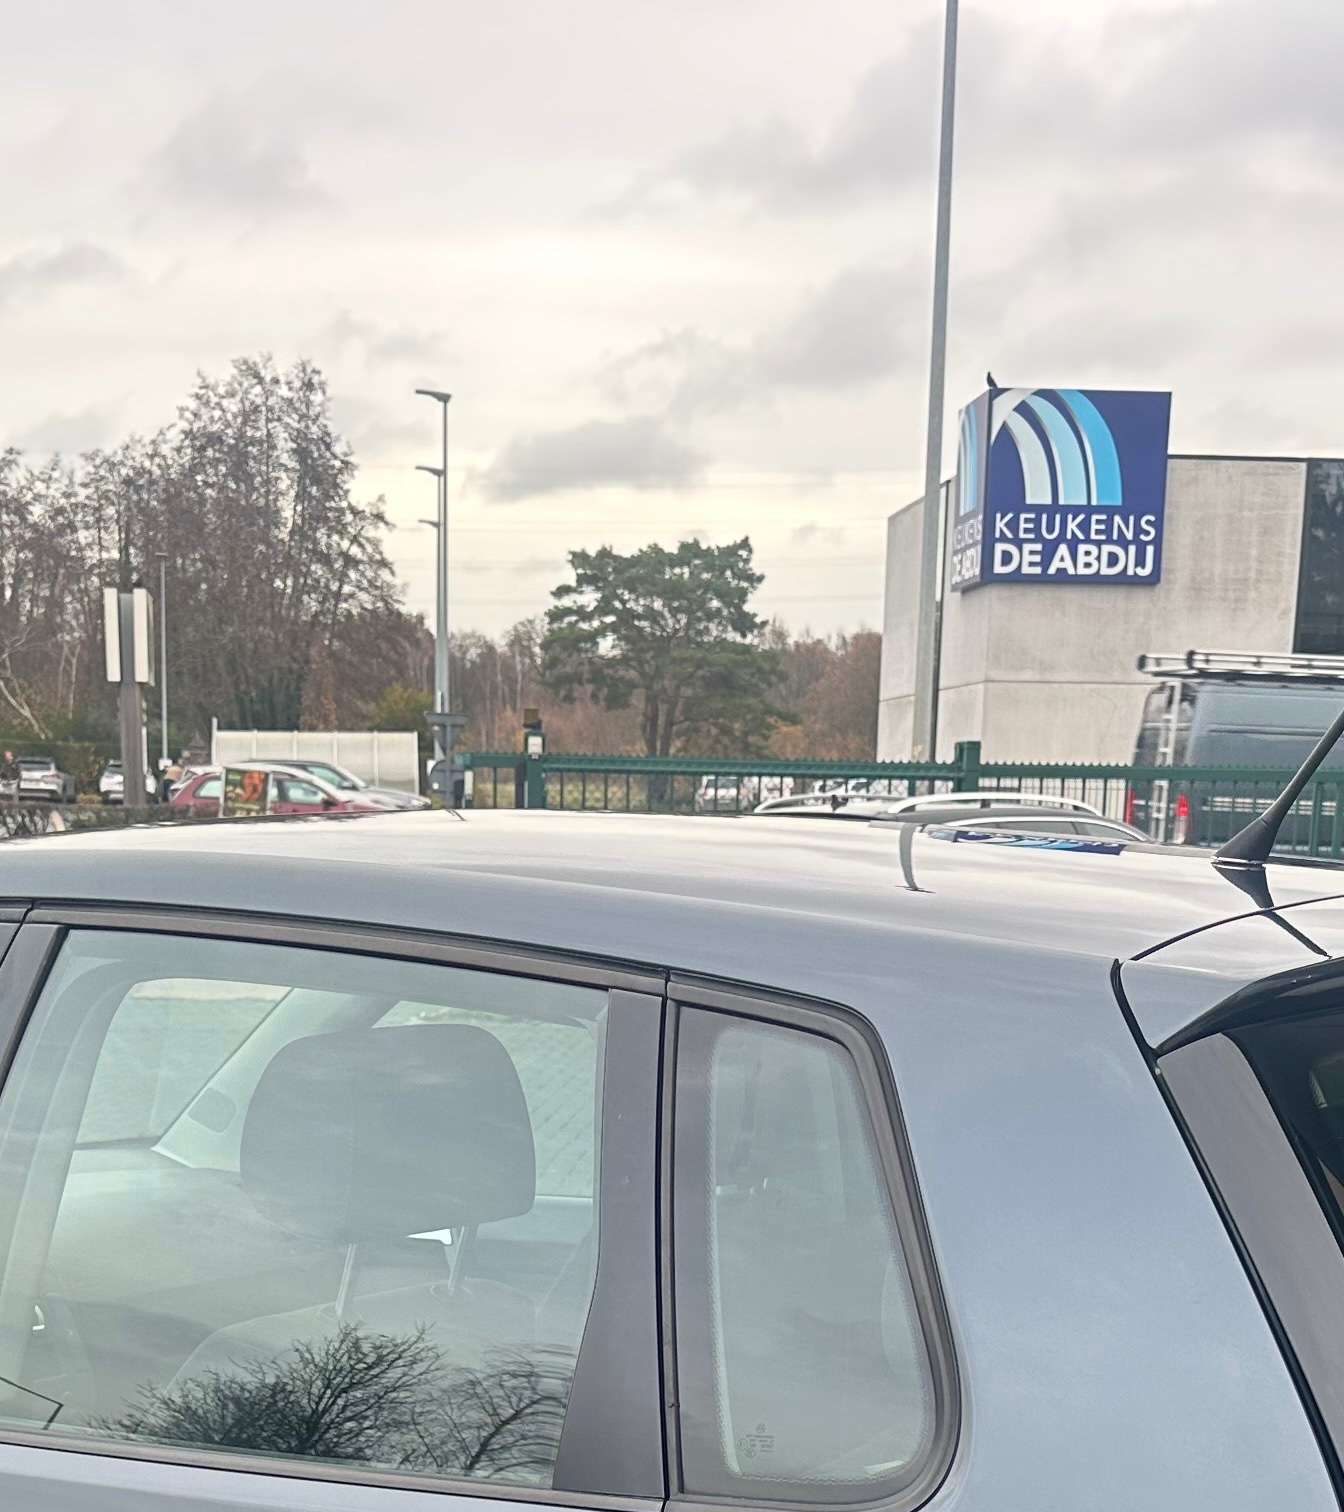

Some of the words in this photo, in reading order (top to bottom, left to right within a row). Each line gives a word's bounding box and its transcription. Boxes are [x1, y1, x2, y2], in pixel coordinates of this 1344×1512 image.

[994, 512, 1156, 541] KEUKENS
[993, 542, 1042, 575] DE
[1047, 543, 1154, 577] ABDIJ
